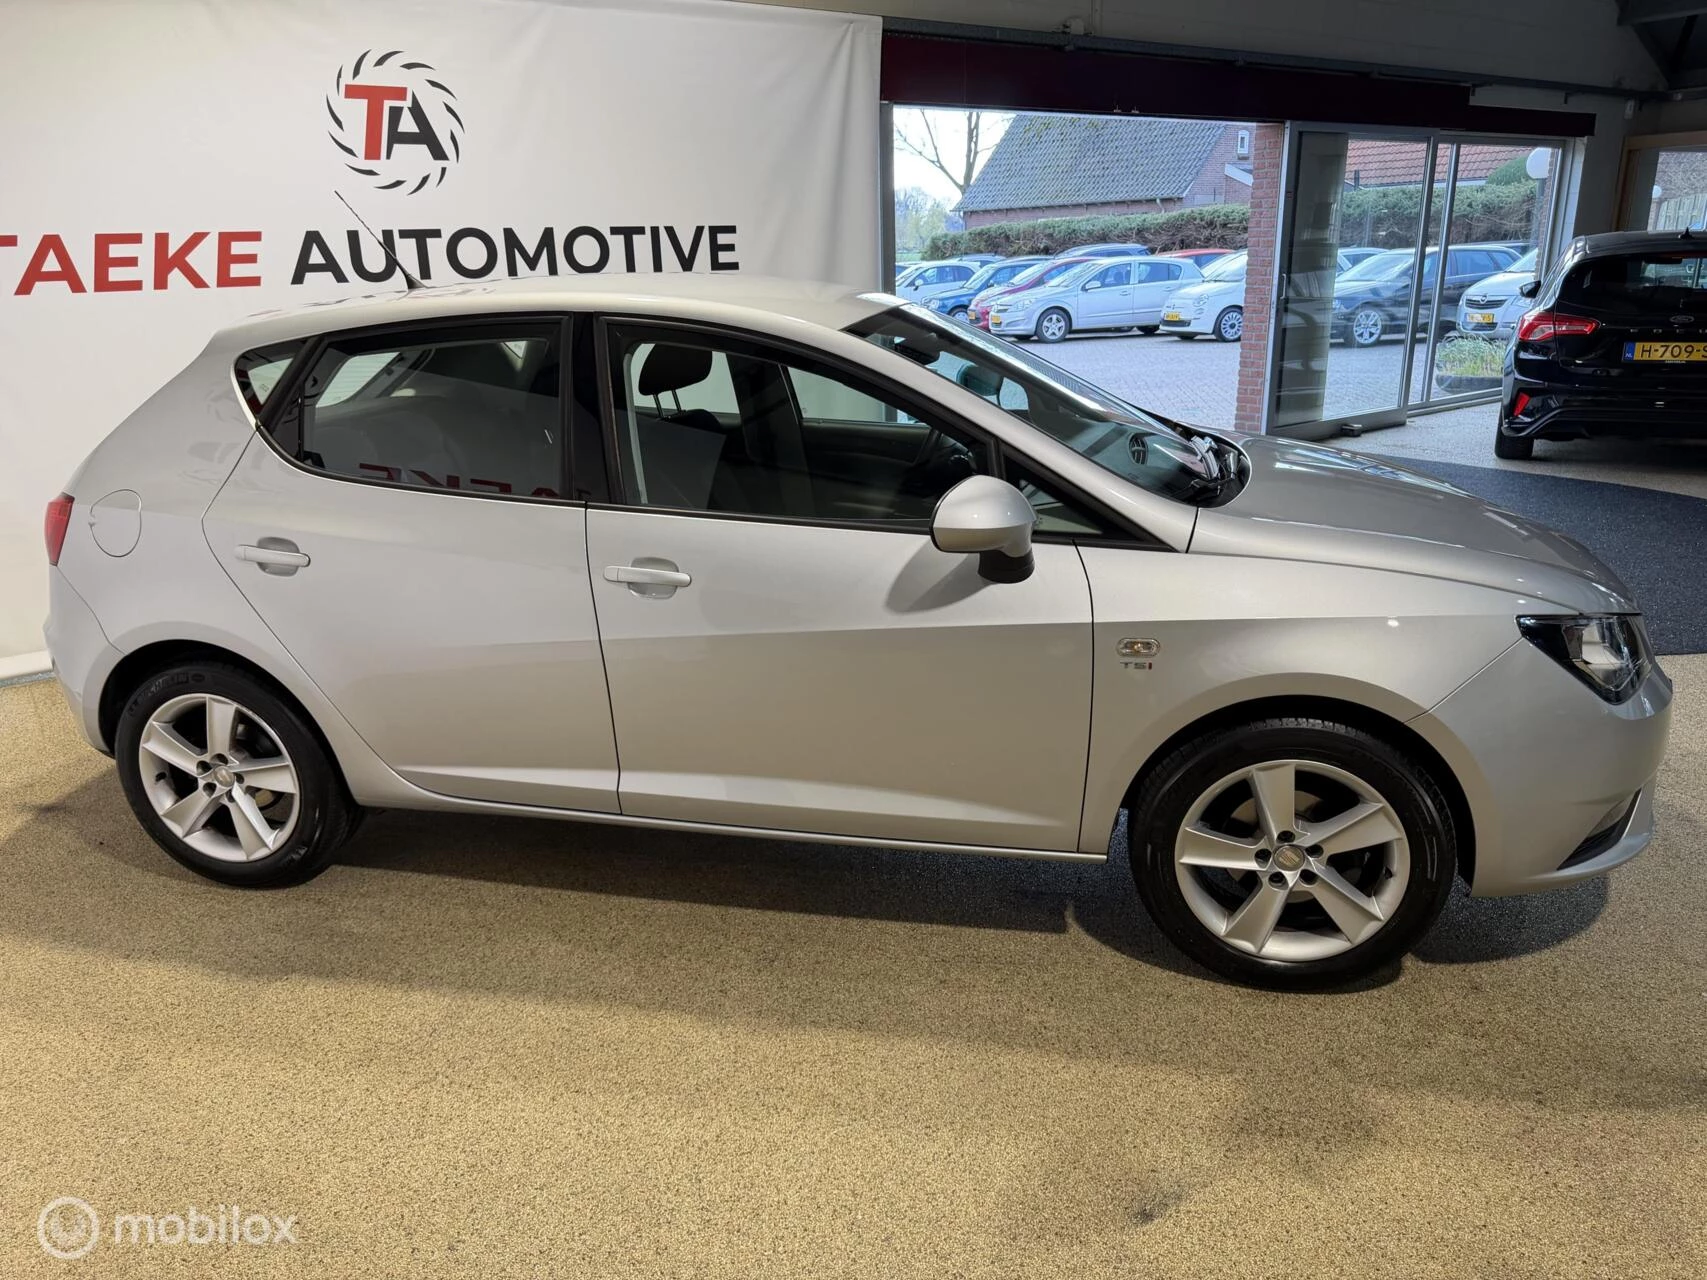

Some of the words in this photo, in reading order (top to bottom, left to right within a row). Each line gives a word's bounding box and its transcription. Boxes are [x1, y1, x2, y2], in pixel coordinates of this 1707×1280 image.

[344, 84, 450, 161] TA
[290, 225, 740, 285] AUTOMOTIVE
[1120, 661, 1153, 670] TSI
